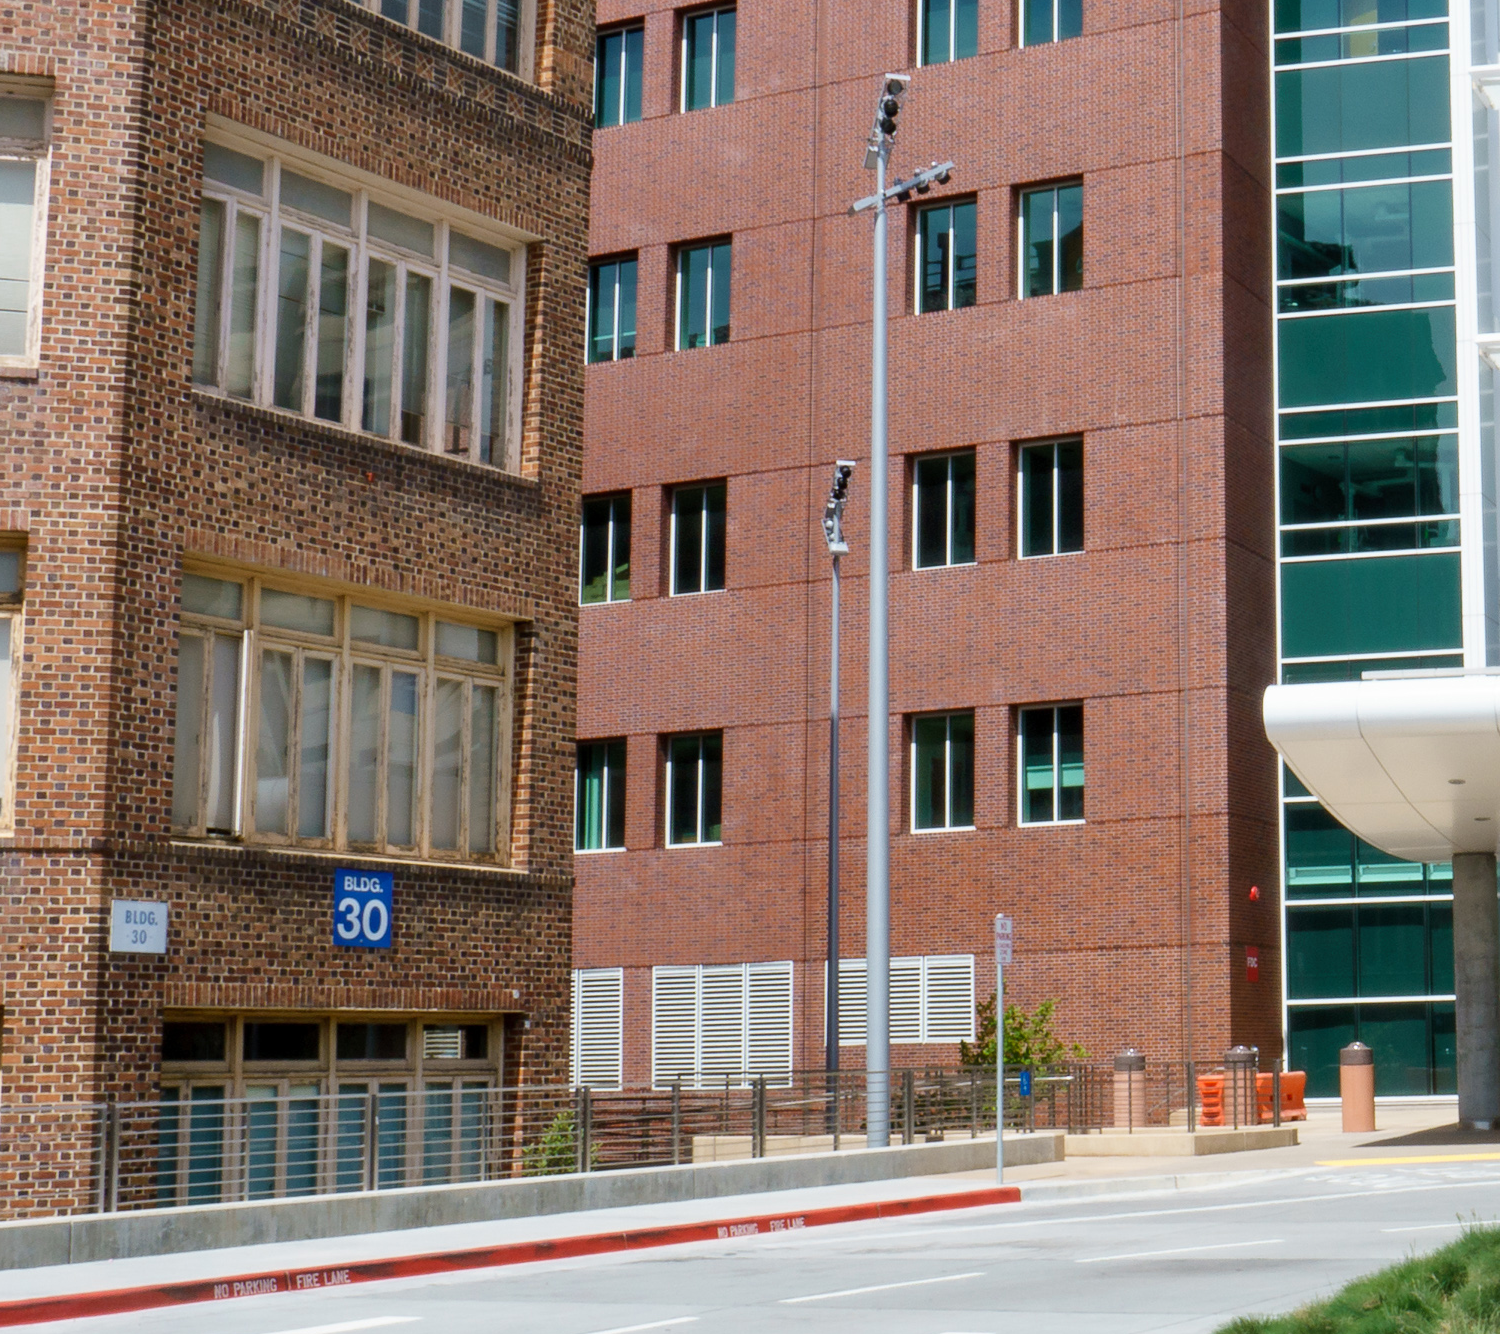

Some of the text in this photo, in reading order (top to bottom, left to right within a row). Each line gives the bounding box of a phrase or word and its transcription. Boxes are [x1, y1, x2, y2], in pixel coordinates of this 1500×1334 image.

[344, 875, 384, 893] BLDG.
[125, 910, 158, 926] BLDG.
[337, 897, 389, 941] 30
[131, 929, 147, 945] 30
[717, 1222, 759, 1239] NO PARKING
[296, 1269, 351, 1289] FIRE LANE
[213, 1278, 278, 1299] NO PARKING
